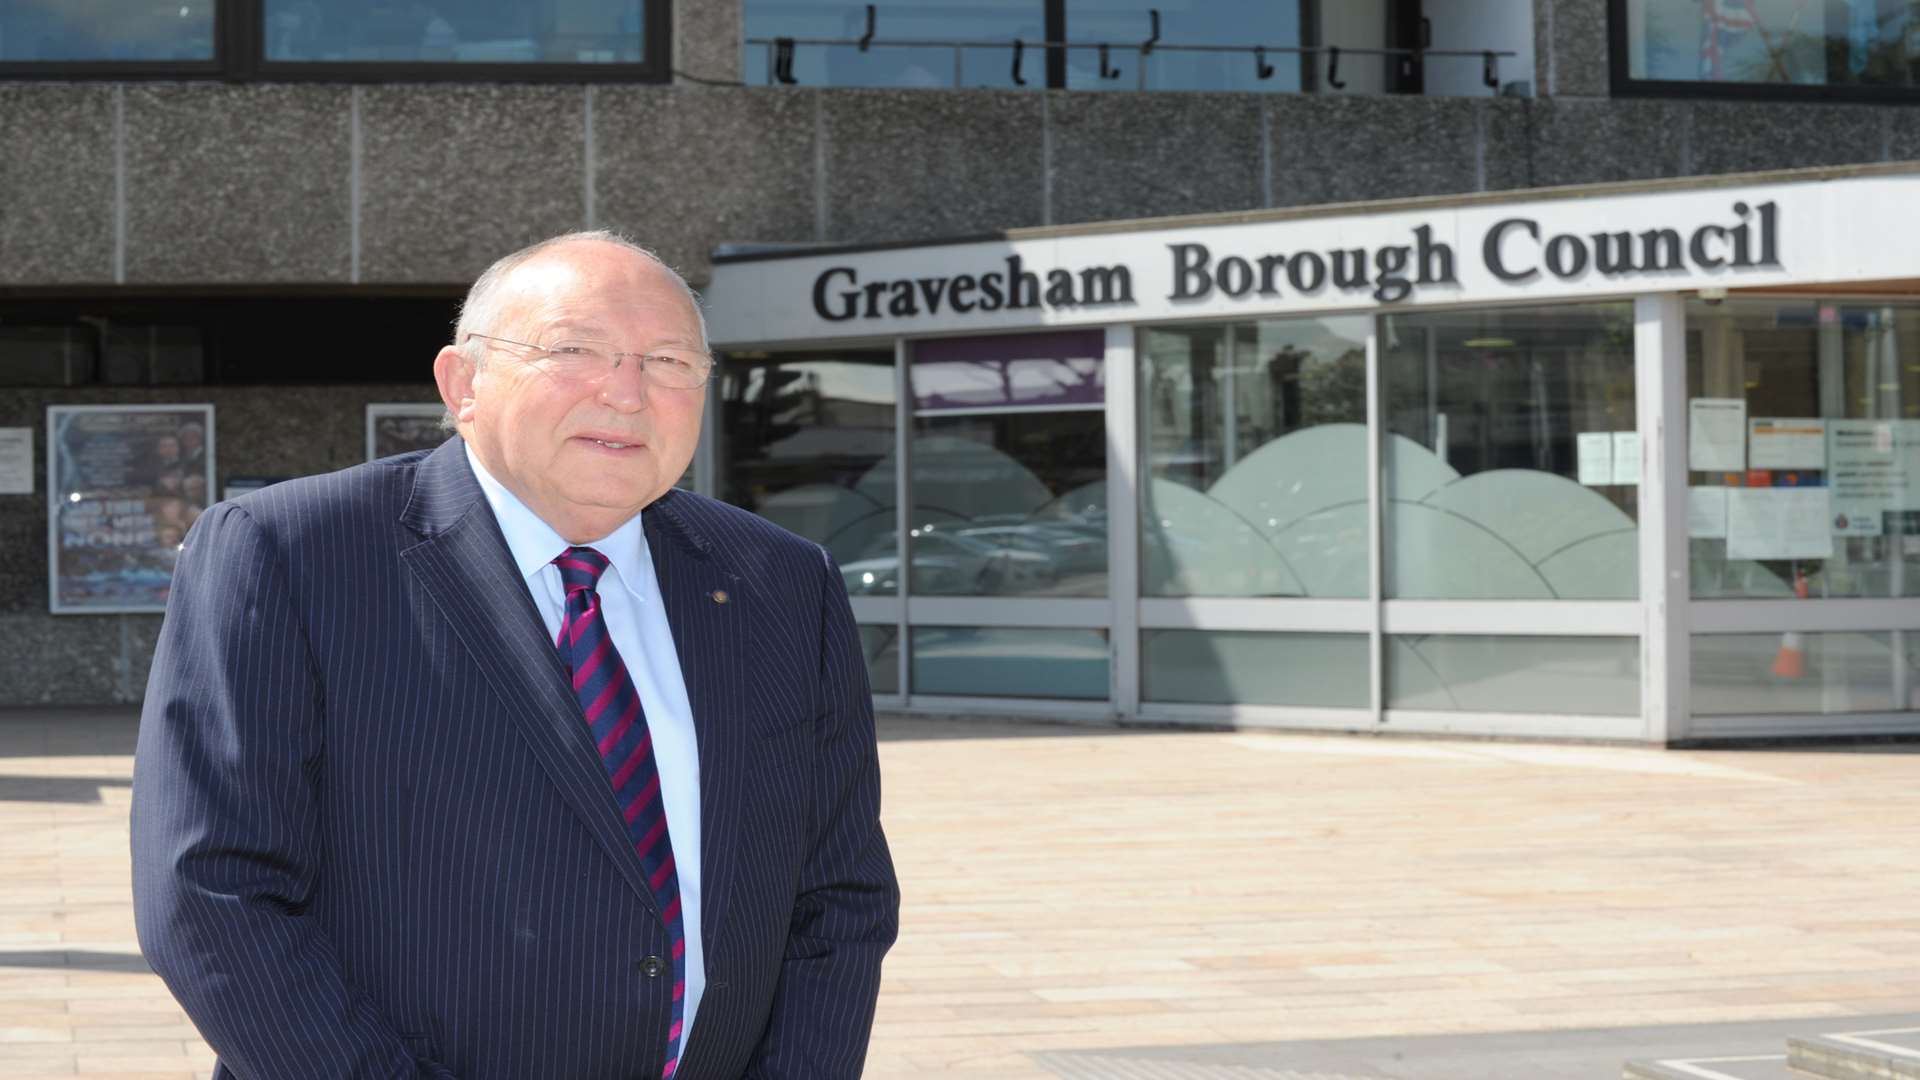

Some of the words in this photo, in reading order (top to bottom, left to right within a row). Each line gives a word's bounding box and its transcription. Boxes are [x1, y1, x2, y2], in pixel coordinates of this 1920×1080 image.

[812, 254, 1136, 322] Gravesham
[1166, 223, 1460, 303] Borough
[1482, 200, 1784, 282] Council
